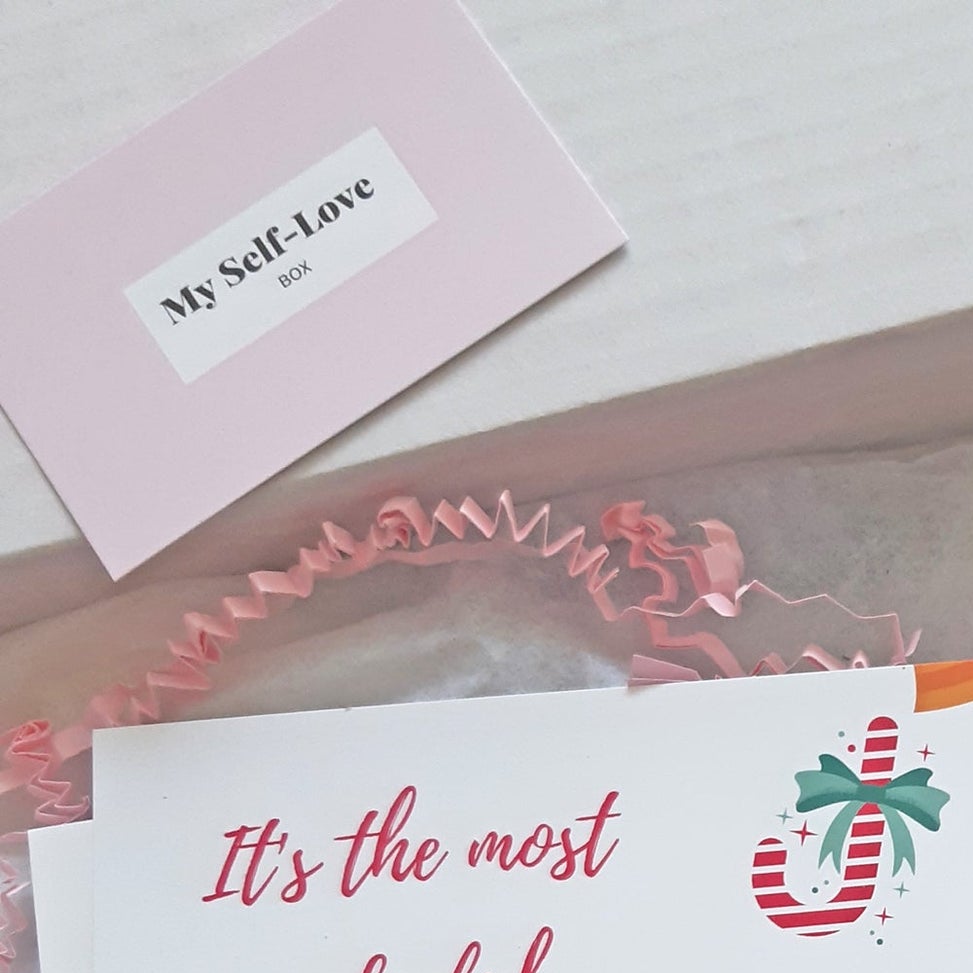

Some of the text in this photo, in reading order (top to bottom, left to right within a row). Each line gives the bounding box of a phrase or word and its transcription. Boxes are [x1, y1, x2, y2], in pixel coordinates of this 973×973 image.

[159, 177, 375, 326] My Self-Love
[278, 259, 313, 289] BOX
[203, 785, 621, 907] It's the most
